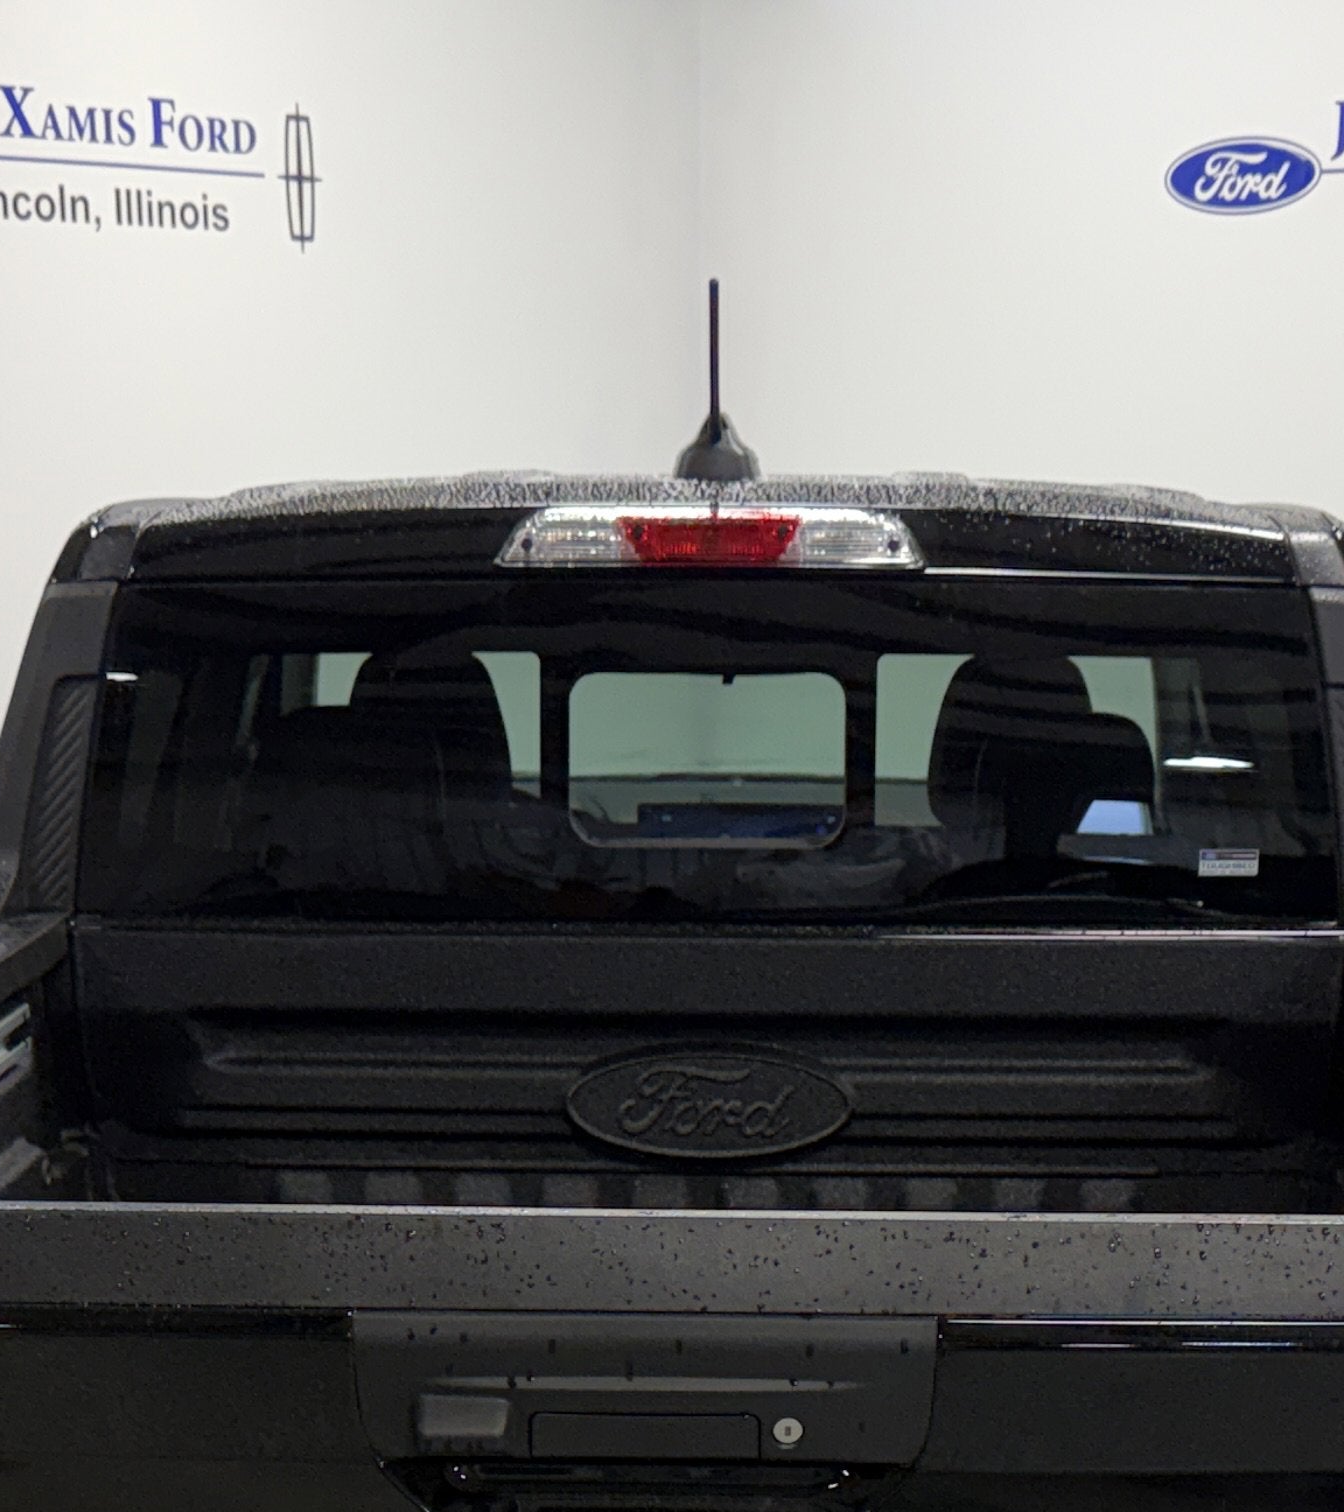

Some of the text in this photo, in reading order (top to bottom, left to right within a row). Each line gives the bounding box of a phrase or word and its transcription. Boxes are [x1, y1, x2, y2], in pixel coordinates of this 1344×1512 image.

[149, 98, 256, 153] FORD
[1193, 151, 1288, 202] Ford
[115, 189, 229, 231] Illinois
[618, 1065, 795, 1138] Ford
